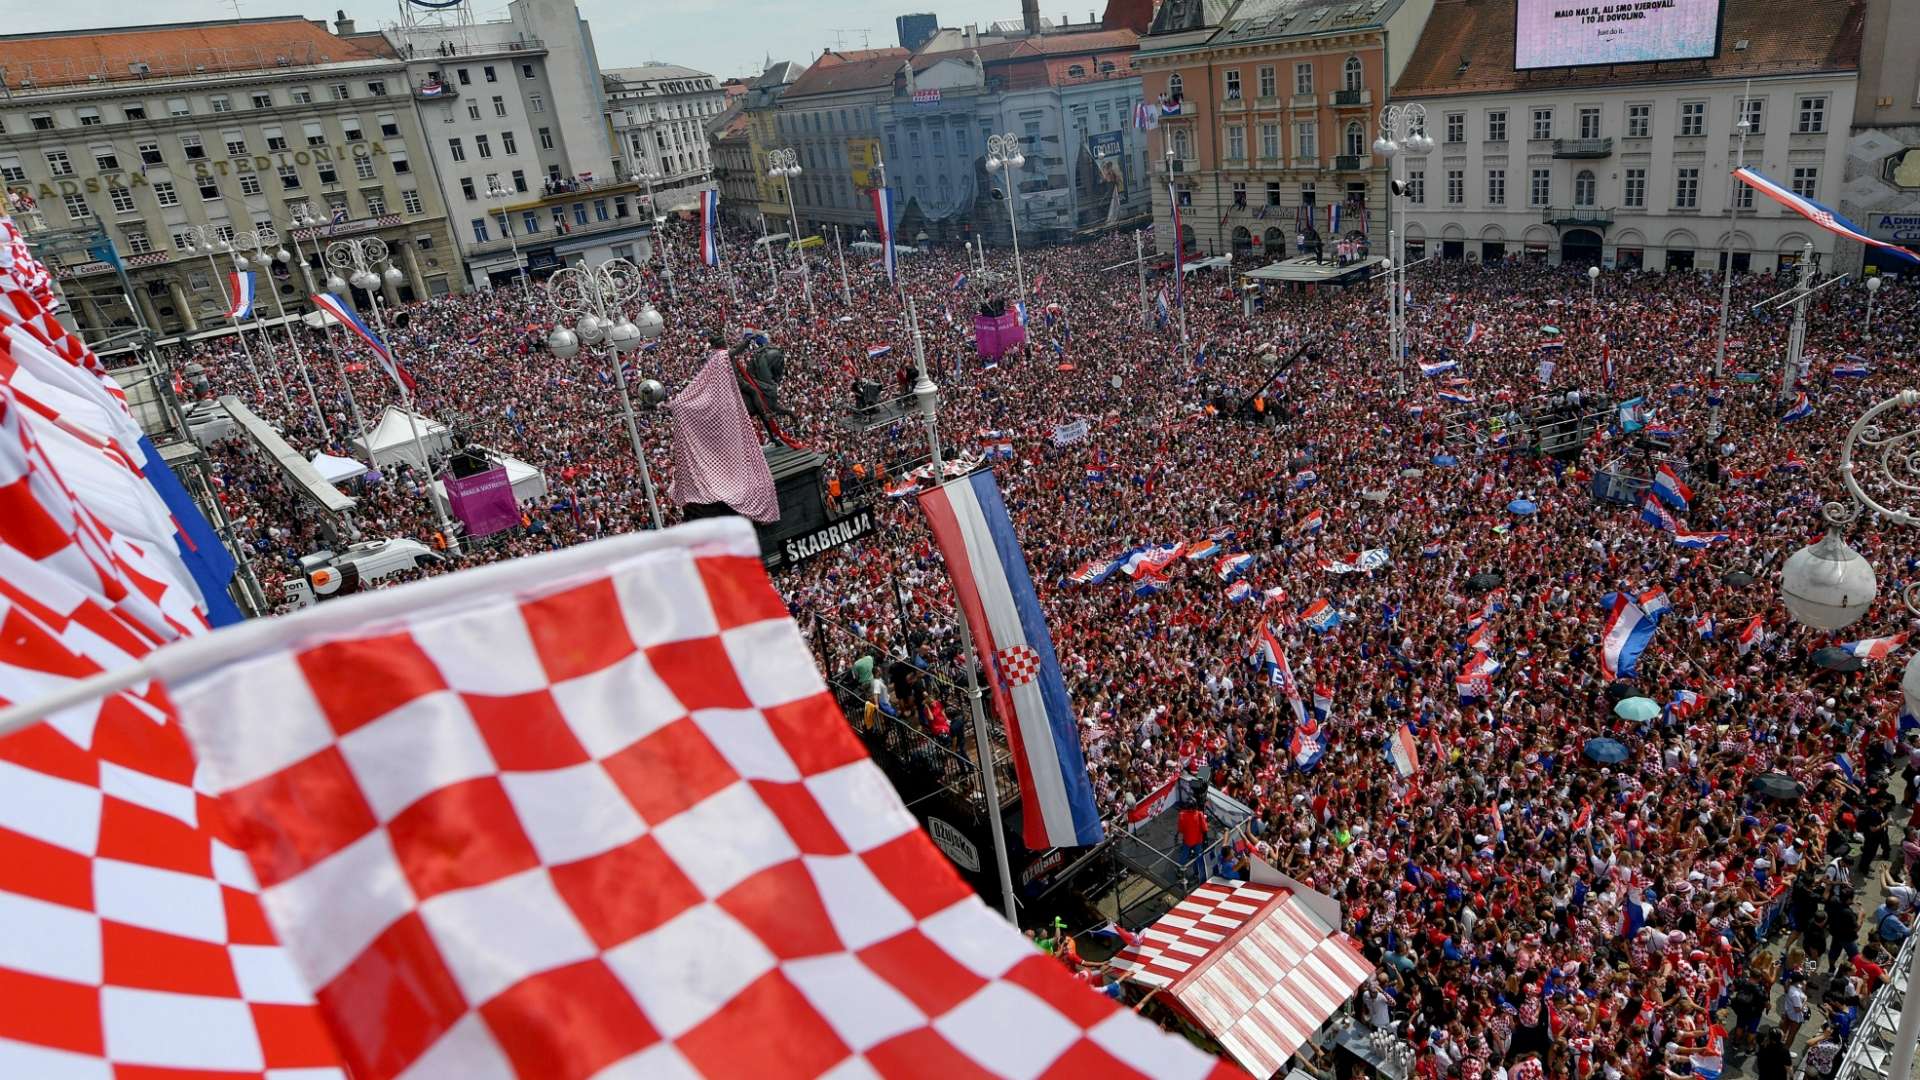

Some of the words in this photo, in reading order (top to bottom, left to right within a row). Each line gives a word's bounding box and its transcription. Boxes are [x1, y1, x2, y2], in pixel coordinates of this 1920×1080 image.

[1602, 6, 1613, 14] ALI
[1615, 4, 1632, 12] SMO
[1597, 15, 1604, 23] JE
[786, 512, 871, 562] ŠKABRNJA
